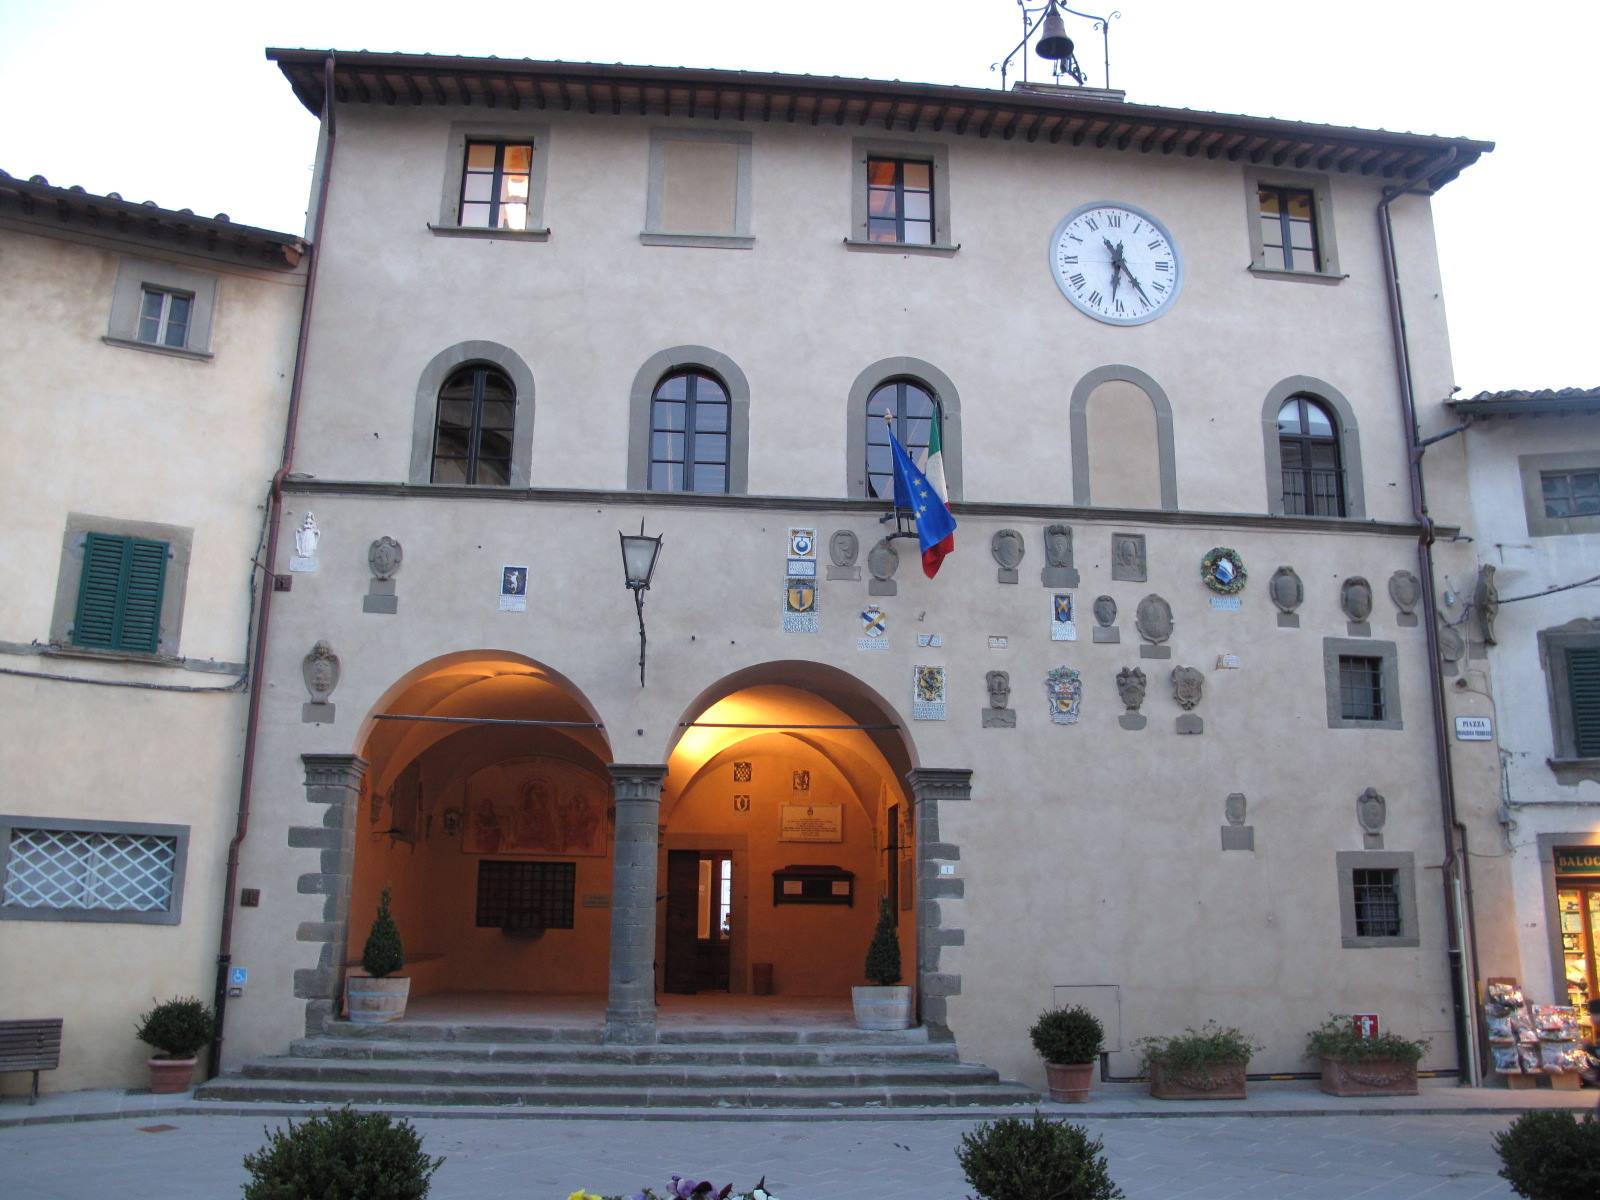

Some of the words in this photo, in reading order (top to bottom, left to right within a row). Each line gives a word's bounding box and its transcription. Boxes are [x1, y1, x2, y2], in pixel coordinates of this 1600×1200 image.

[1106, 214, 1121, 228] XII
[1133, 223, 1141, 234] I
[1147, 240, 1161, 250] II
[1155, 261, 1169, 272] III
[1462, 720, 1486, 728] PIAZZA
